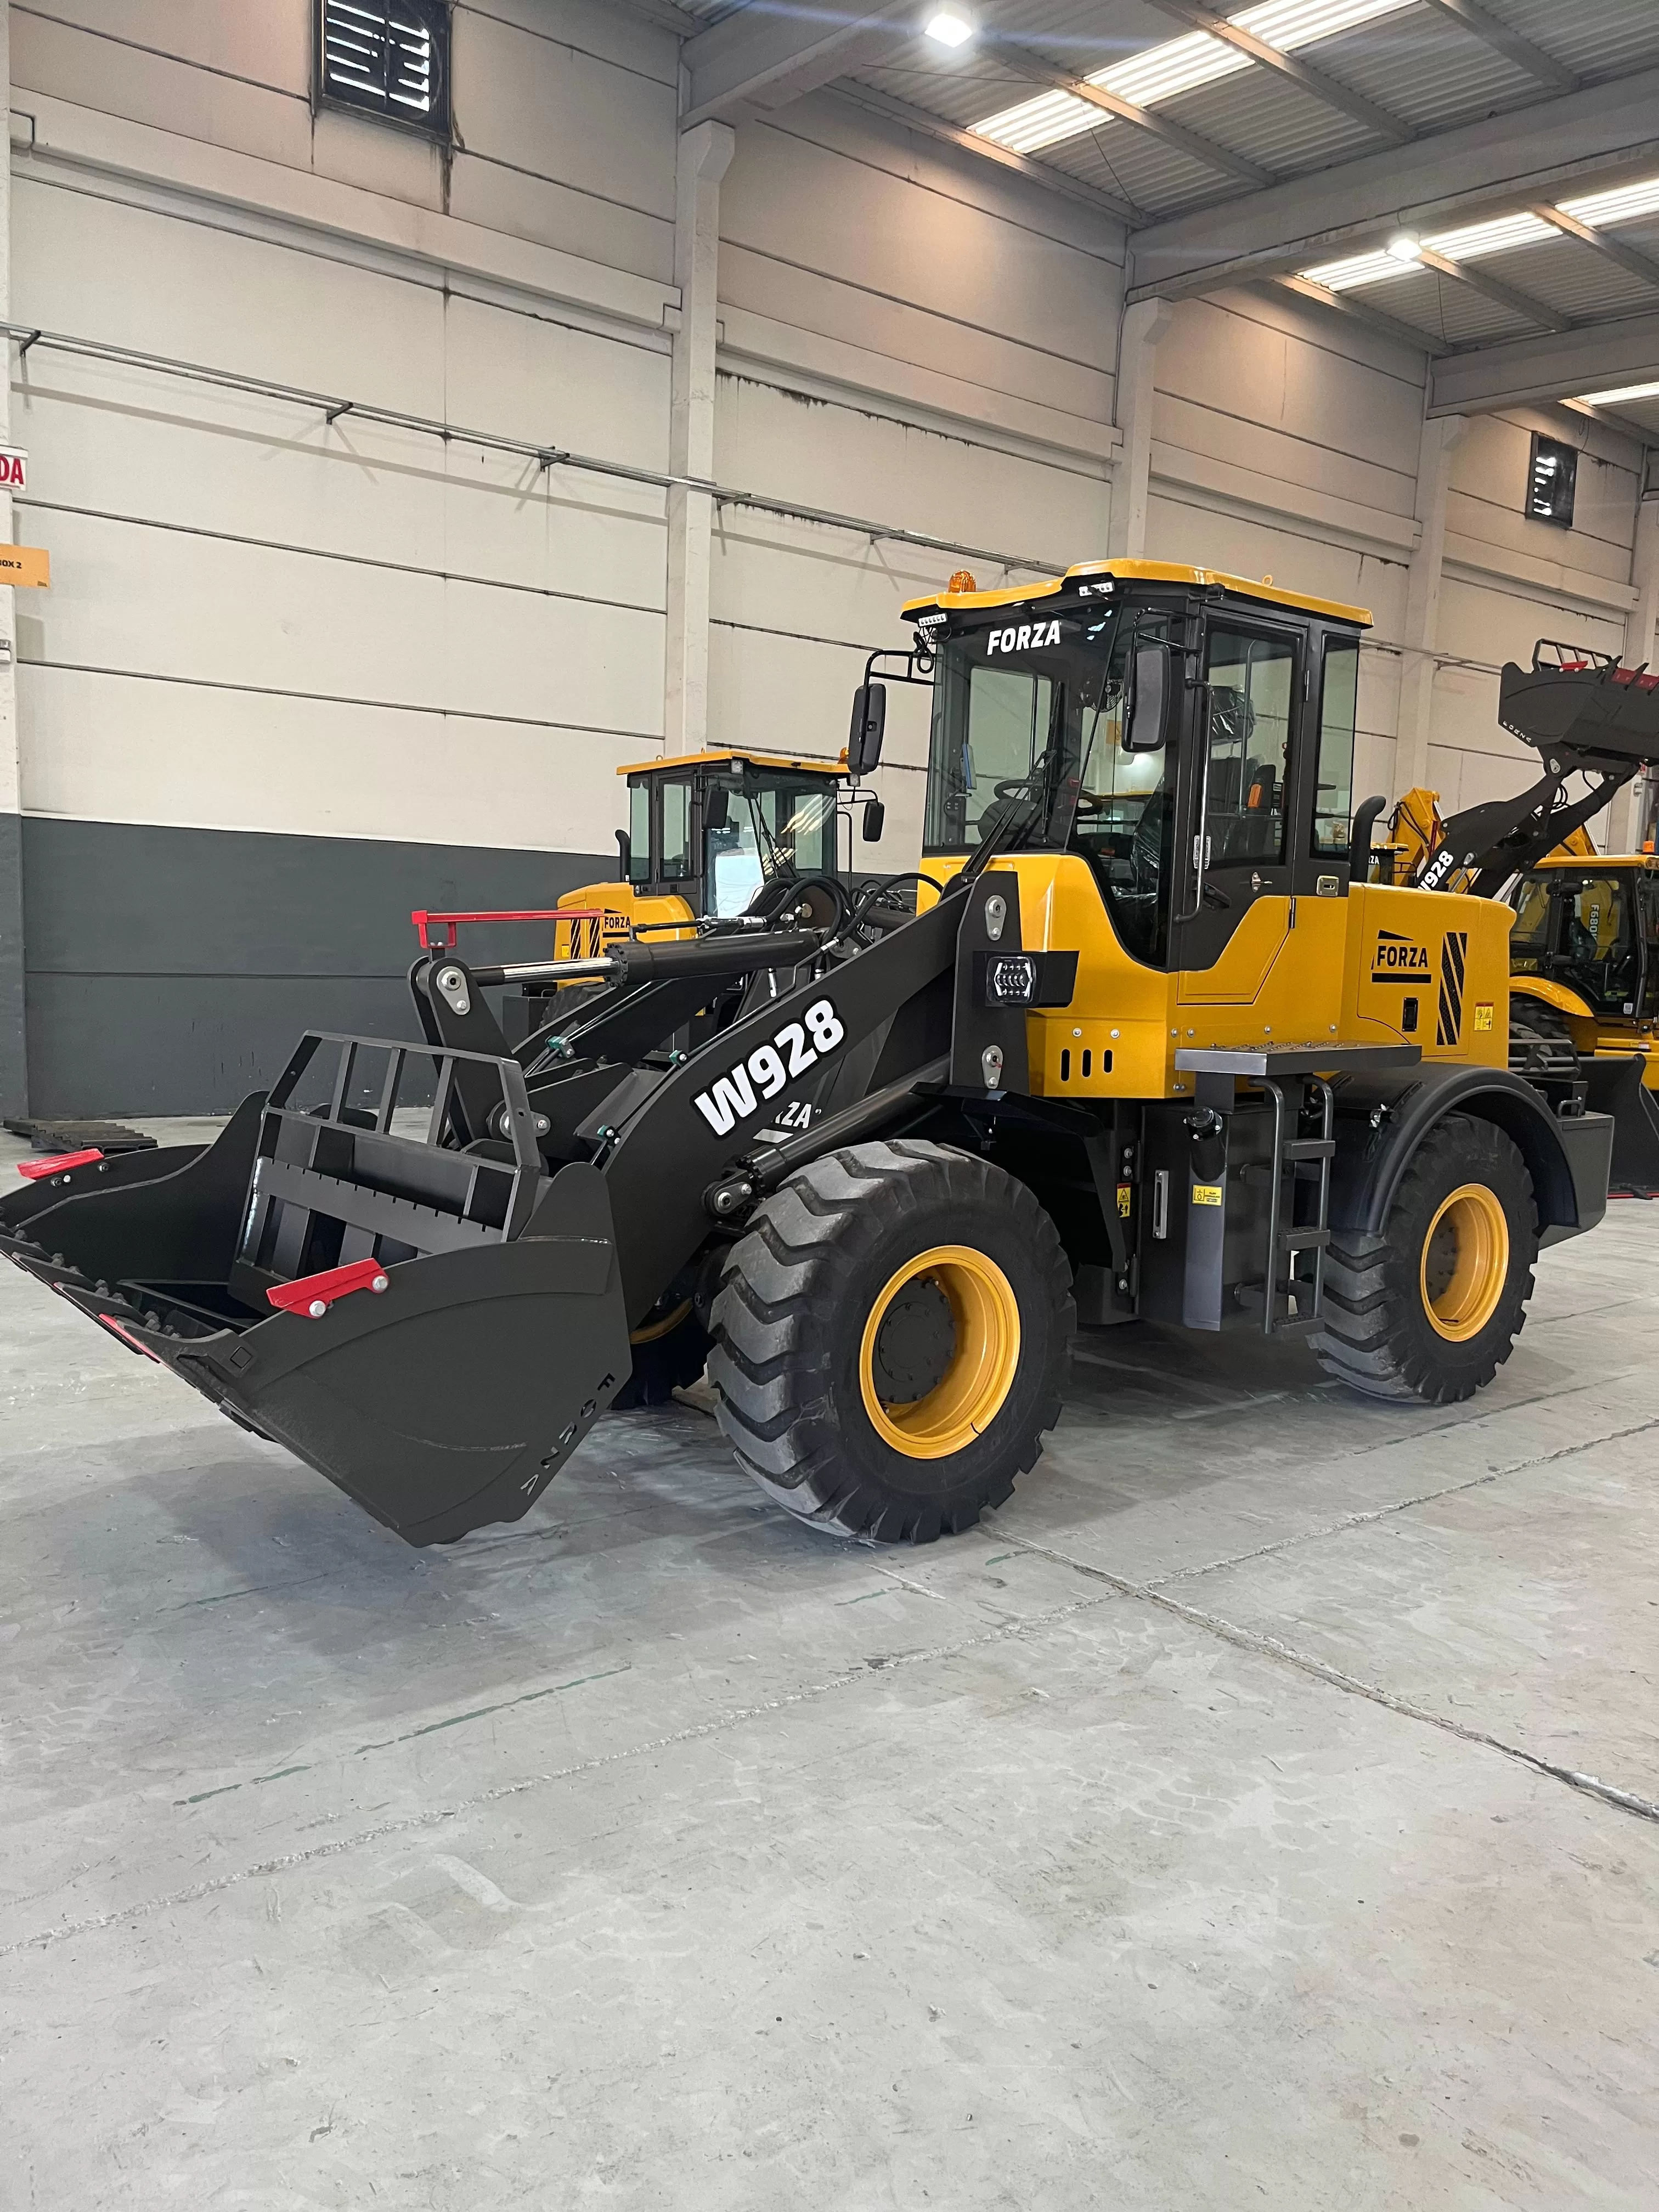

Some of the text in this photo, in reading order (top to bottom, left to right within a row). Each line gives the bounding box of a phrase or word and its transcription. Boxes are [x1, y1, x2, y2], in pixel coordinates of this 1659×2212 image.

[987, 619, 1060, 656] FORZA
[1503, 720, 1532, 743] FORZA
[605, 916, 630, 928] FORZA
[1377, 945, 1428, 968] FORZA
[694, 1000, 844, 1136] W928
[521, 1373, 616, 1496] FORZA
